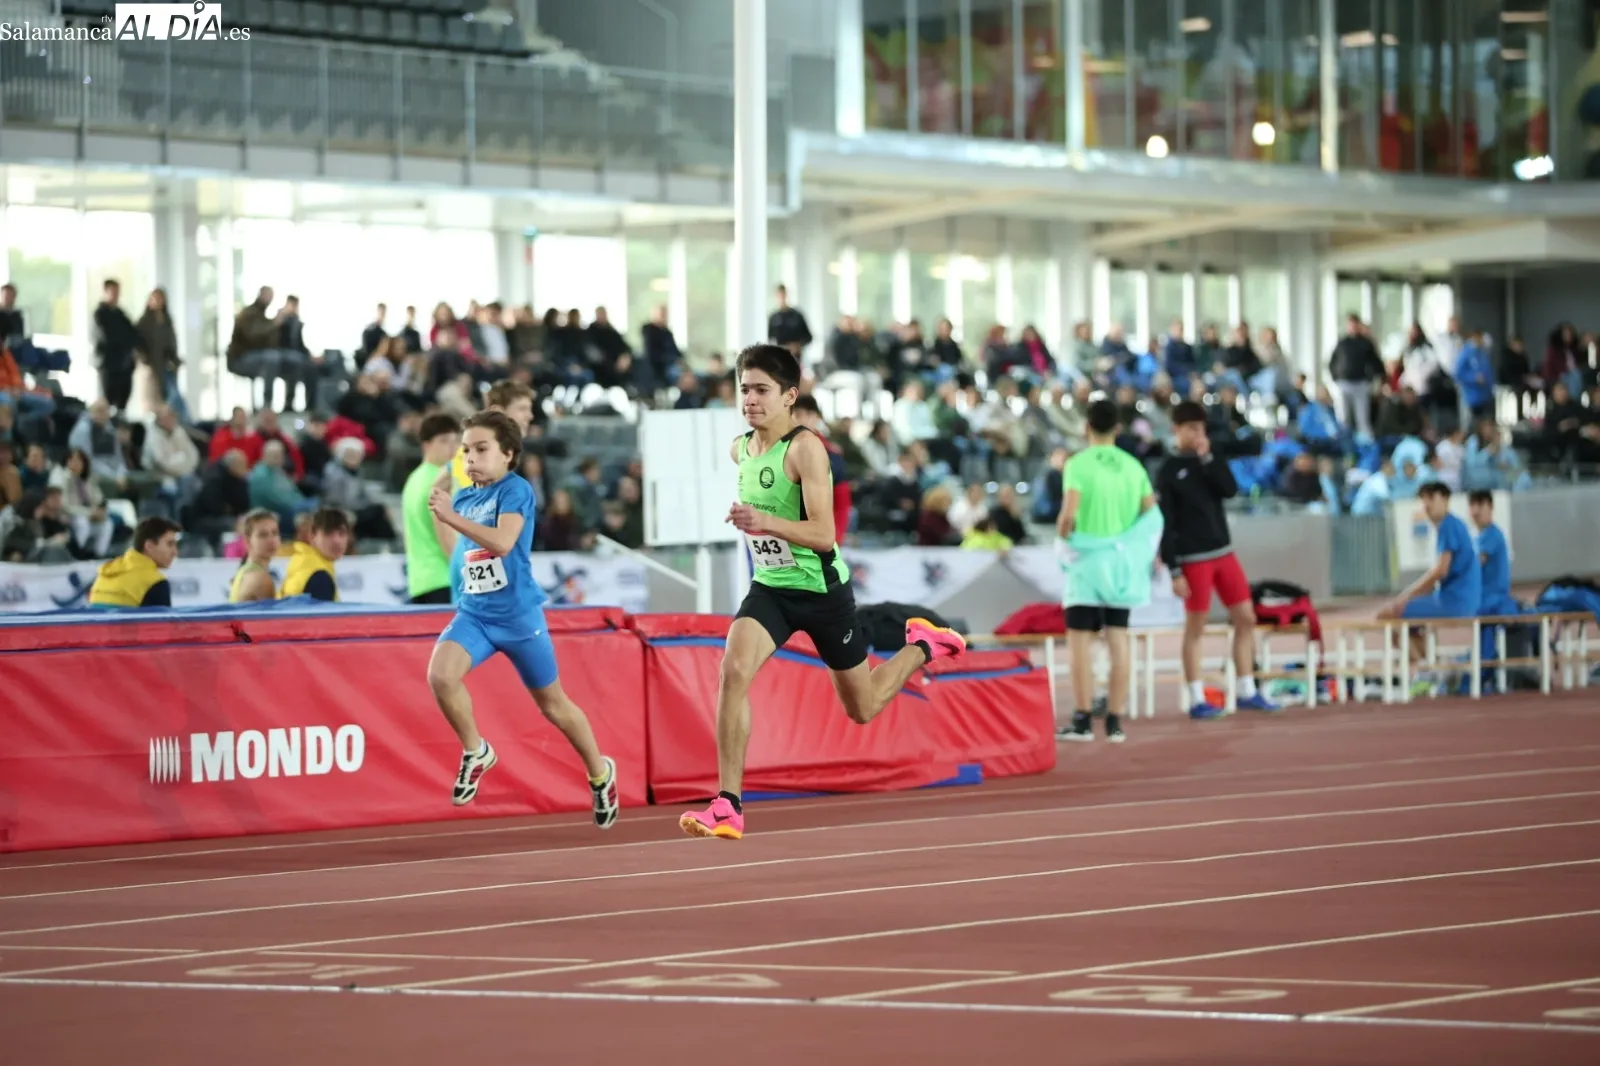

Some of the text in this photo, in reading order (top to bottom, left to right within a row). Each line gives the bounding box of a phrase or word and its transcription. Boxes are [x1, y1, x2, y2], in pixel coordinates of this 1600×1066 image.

[752, 540, 782, 555] 543
[469, 563, 495, 581] 621
[190, 724, 365, 783] MONDO
